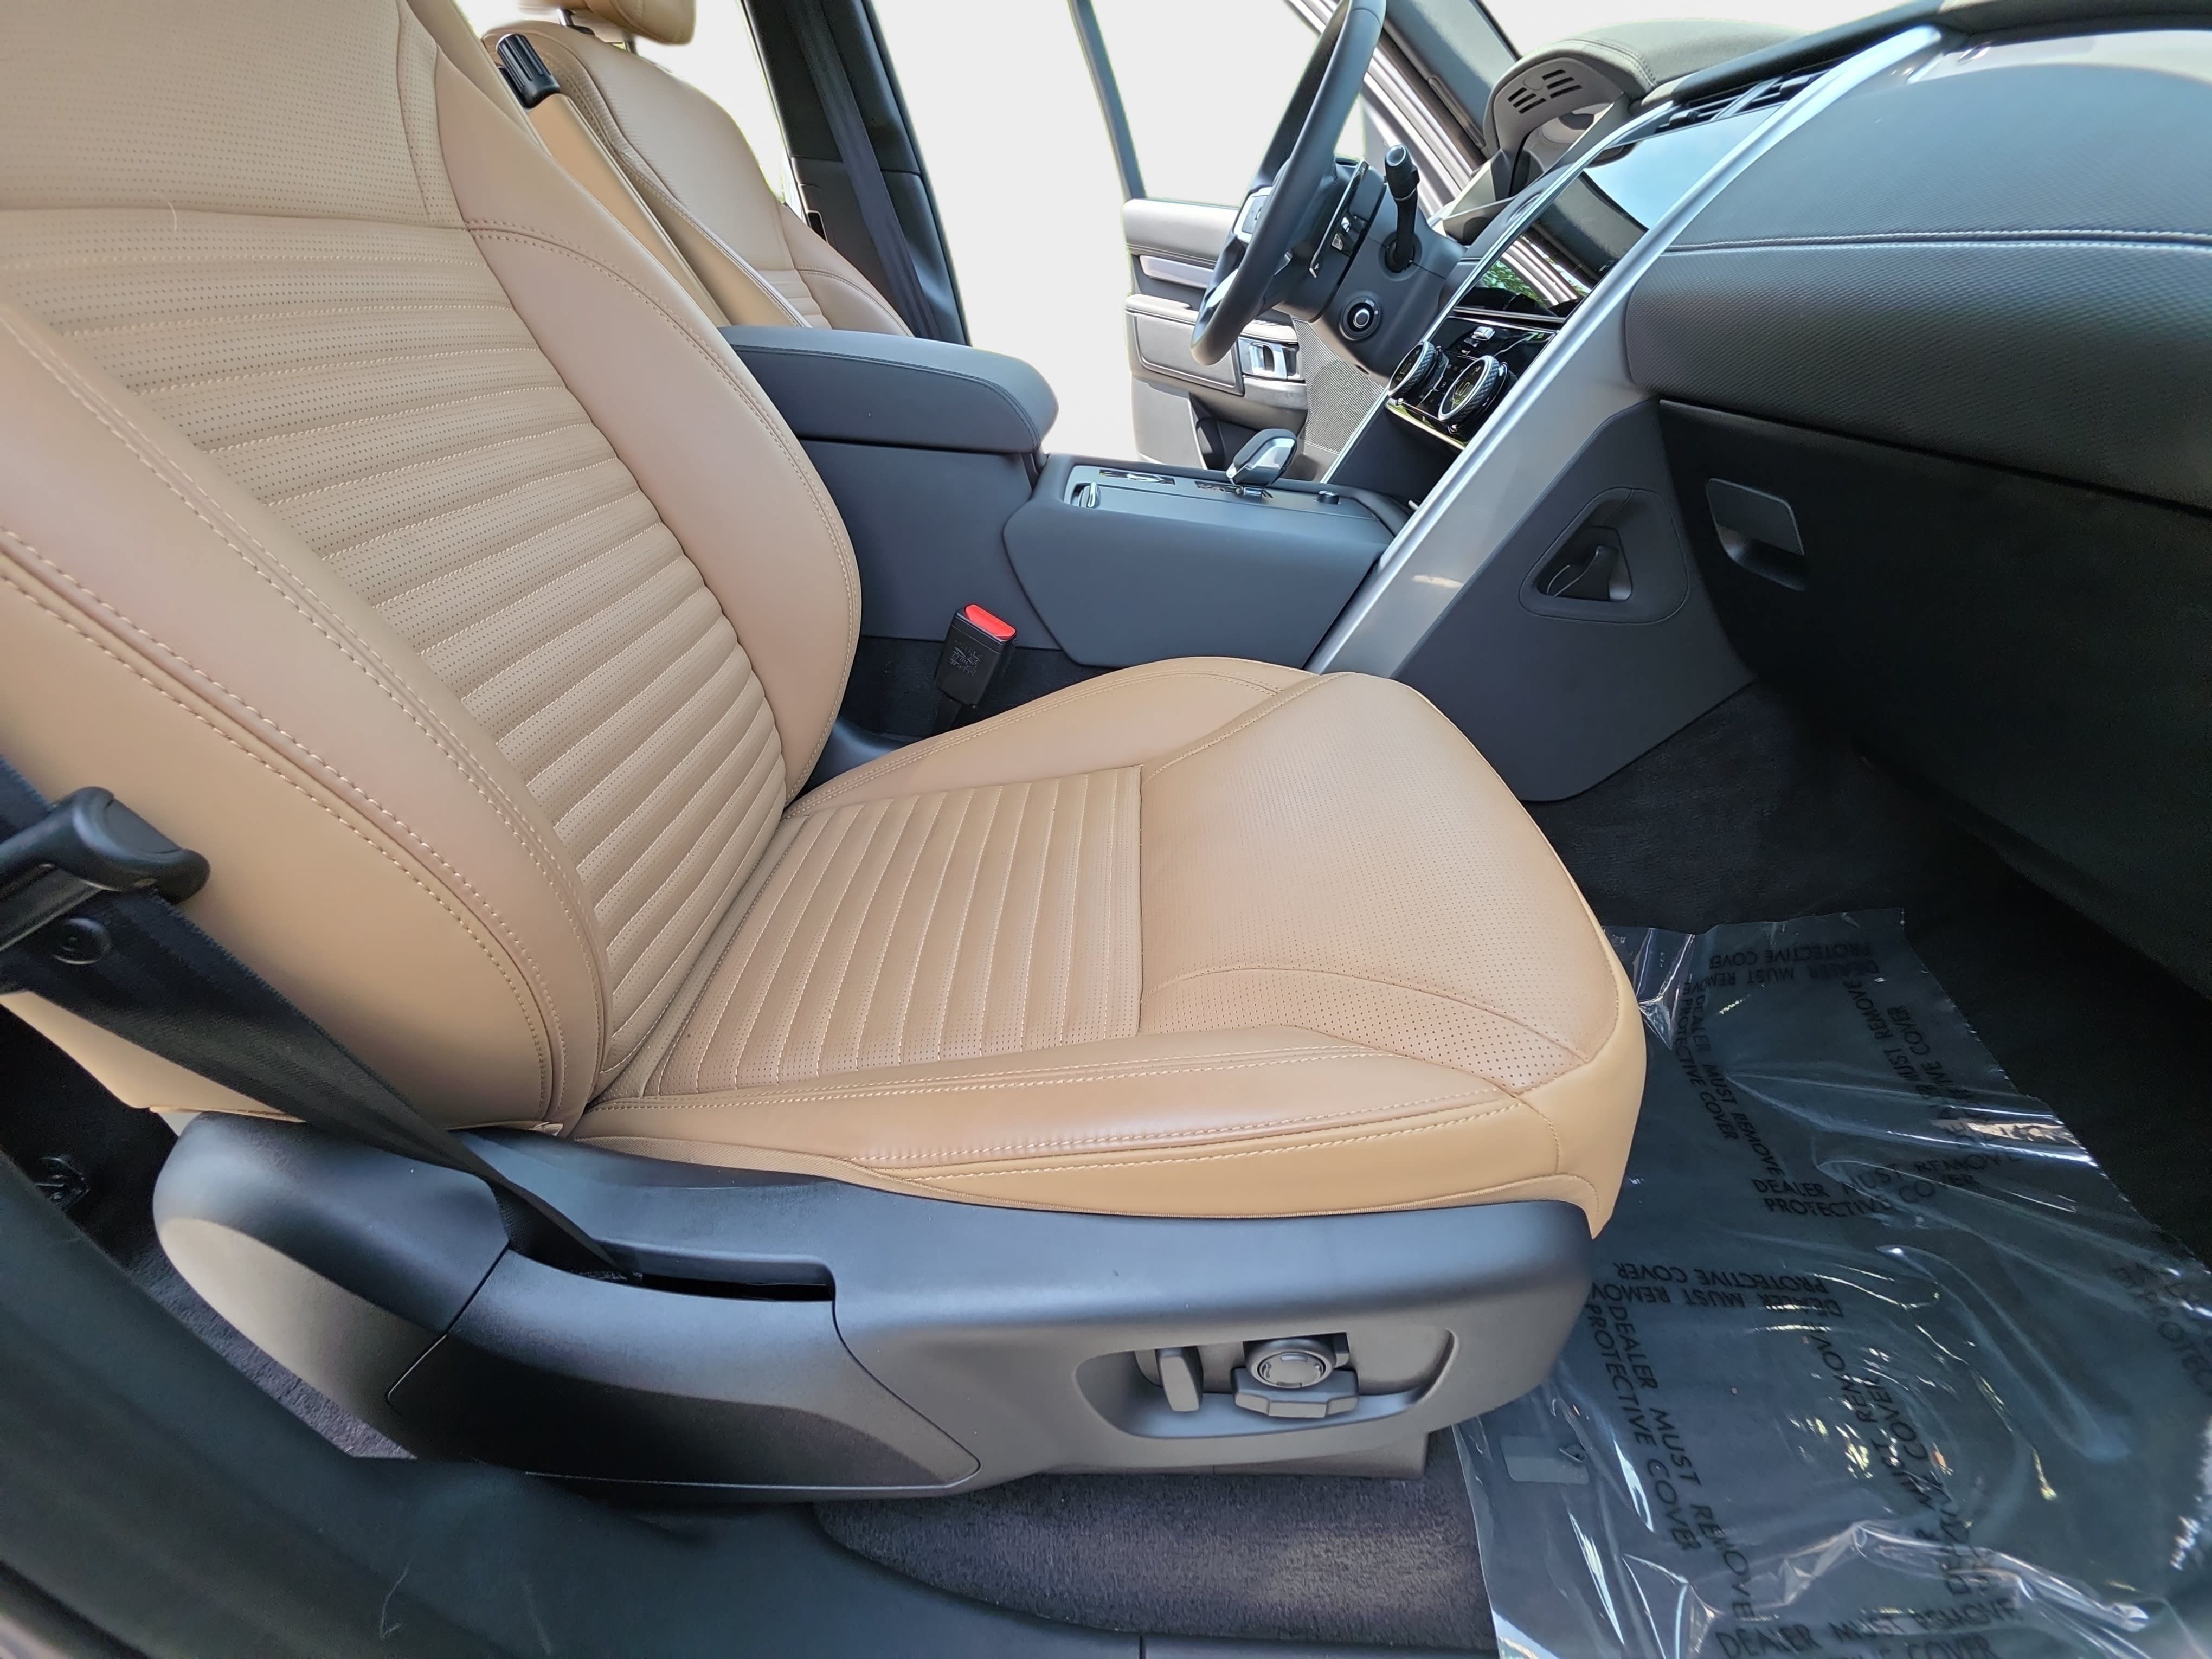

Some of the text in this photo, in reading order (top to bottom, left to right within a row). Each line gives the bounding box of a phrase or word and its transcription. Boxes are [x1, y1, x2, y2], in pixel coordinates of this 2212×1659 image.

[1708, 950, 1758, 969] COVER
[1747, 968, 1795, 985] MUST
[1843, 979, 1893, 1040] REMOVE
[1887, 1005, 1930, 1056] COVER
[1689, 996, 1786, 1177] DEALER MUST REMOVE
[1699, 1091, 1739, 1141] COVER
[1751, 1178, 1831, 1199] DEALER
[1761, 1197, 1893, 1218] PROTECTIVE
[1590, 1282, 1673, 1305] REMOV
[1612, 1262, 1830, 1294] PROTECTIVE COVER
[1682, 1287, 1746, 1308] MUST
[1609, 1306, 1659, 1391] DEALER
[1649, 1406, 1703, 1487] MUST
[1587, 1303, 1702, 1551] PROTECTIVE COVER
